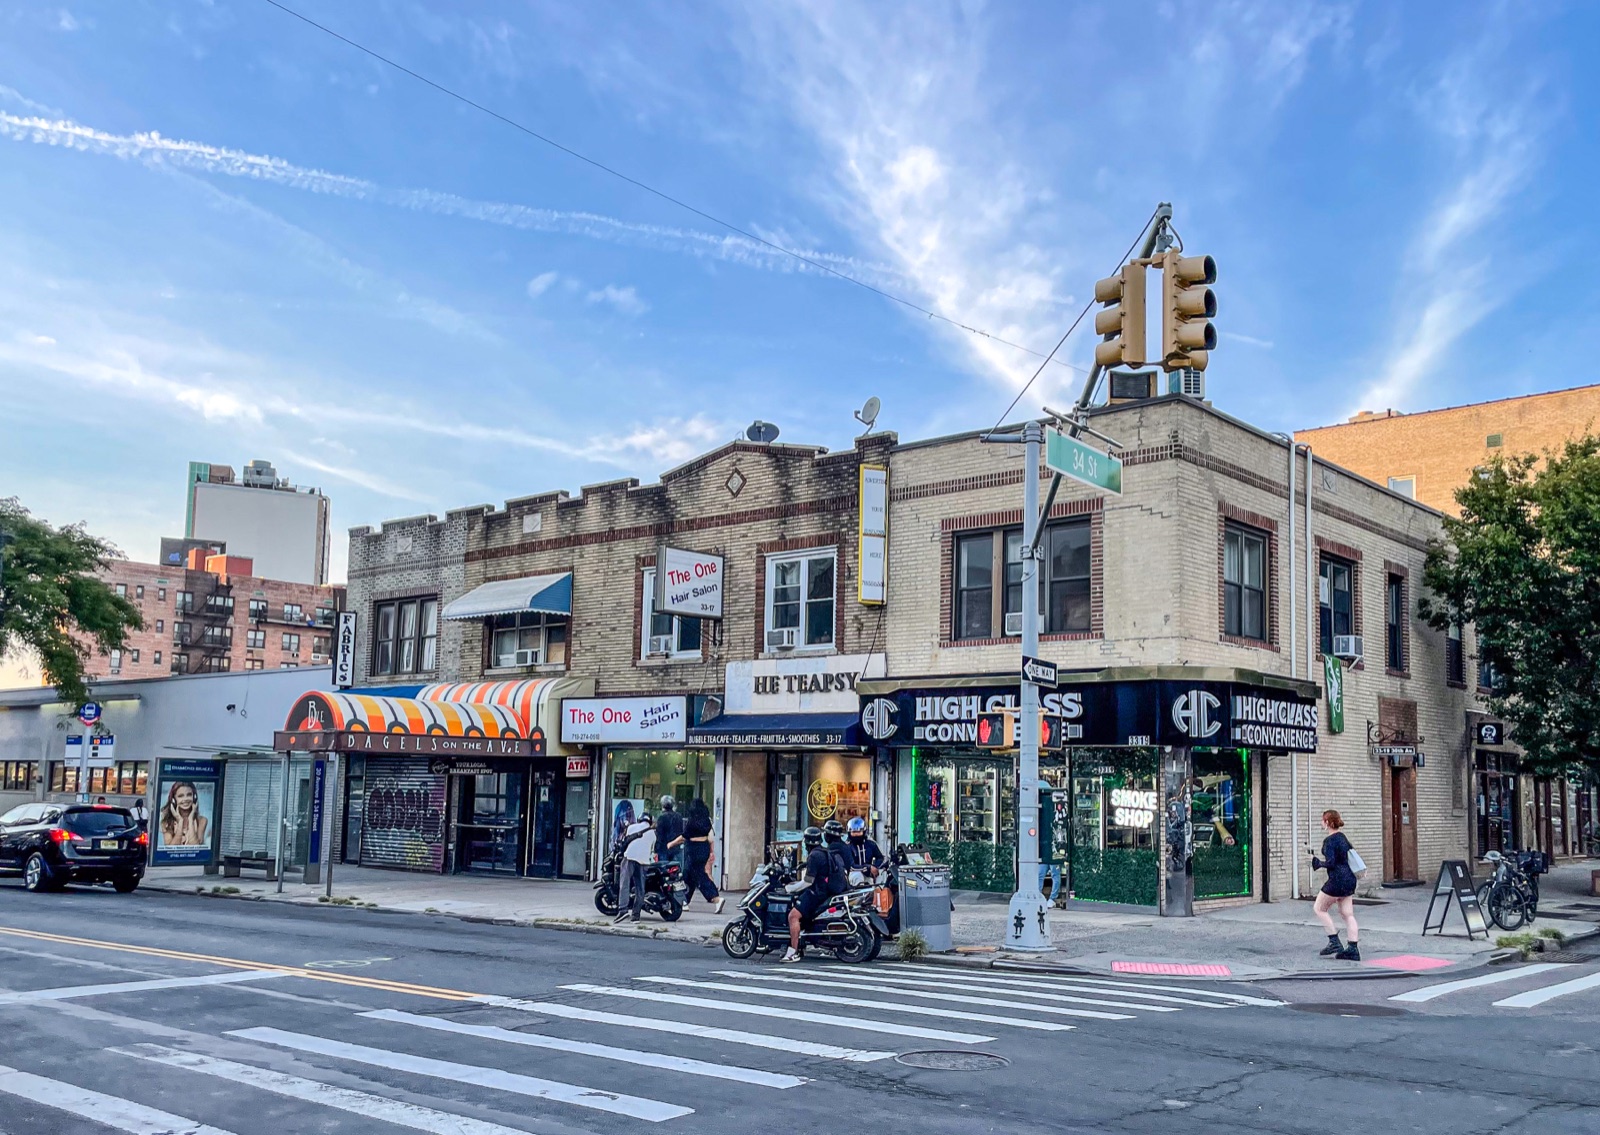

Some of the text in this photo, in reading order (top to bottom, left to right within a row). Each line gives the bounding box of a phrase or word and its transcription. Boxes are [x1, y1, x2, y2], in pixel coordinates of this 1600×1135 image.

[1073, 448, 1097, 479] 34 St
[668, 562, 717, 587] The One
[671, 583, 718, 605] Hair Salon
[700, 603, 715, 612] 33-17
[338, 615, 352, 682] FABRICS
[1027, 664, 1054, 679] ONE WAY
[753, 671, 860, 695] HE TEAPSY
[569, 707, 632, 724] The One
[643, 702, 671, 718] Hair
[915, 694, 981, 720] HIGH
[1243, 695, 1318, 727] HIGH CLASS
[640, 711, 679, 729] Salon
[462, 741, 482, 750] THE
[688, 734, 842, 744] BUBBLE TEA CAFE TEA LATTE FRUIT TEA SMOOTHIES 33-17
[1130, 736, 1150, 746] 3319
[1247, 724, 1314, 749] CONVENIENCE
[568, 761, 589, 771] ATM
[779, 791, 786, 800] A
[1111, 788, 1158, 811] SMOKE
[1115, 807, 1154, 828] SHOP
